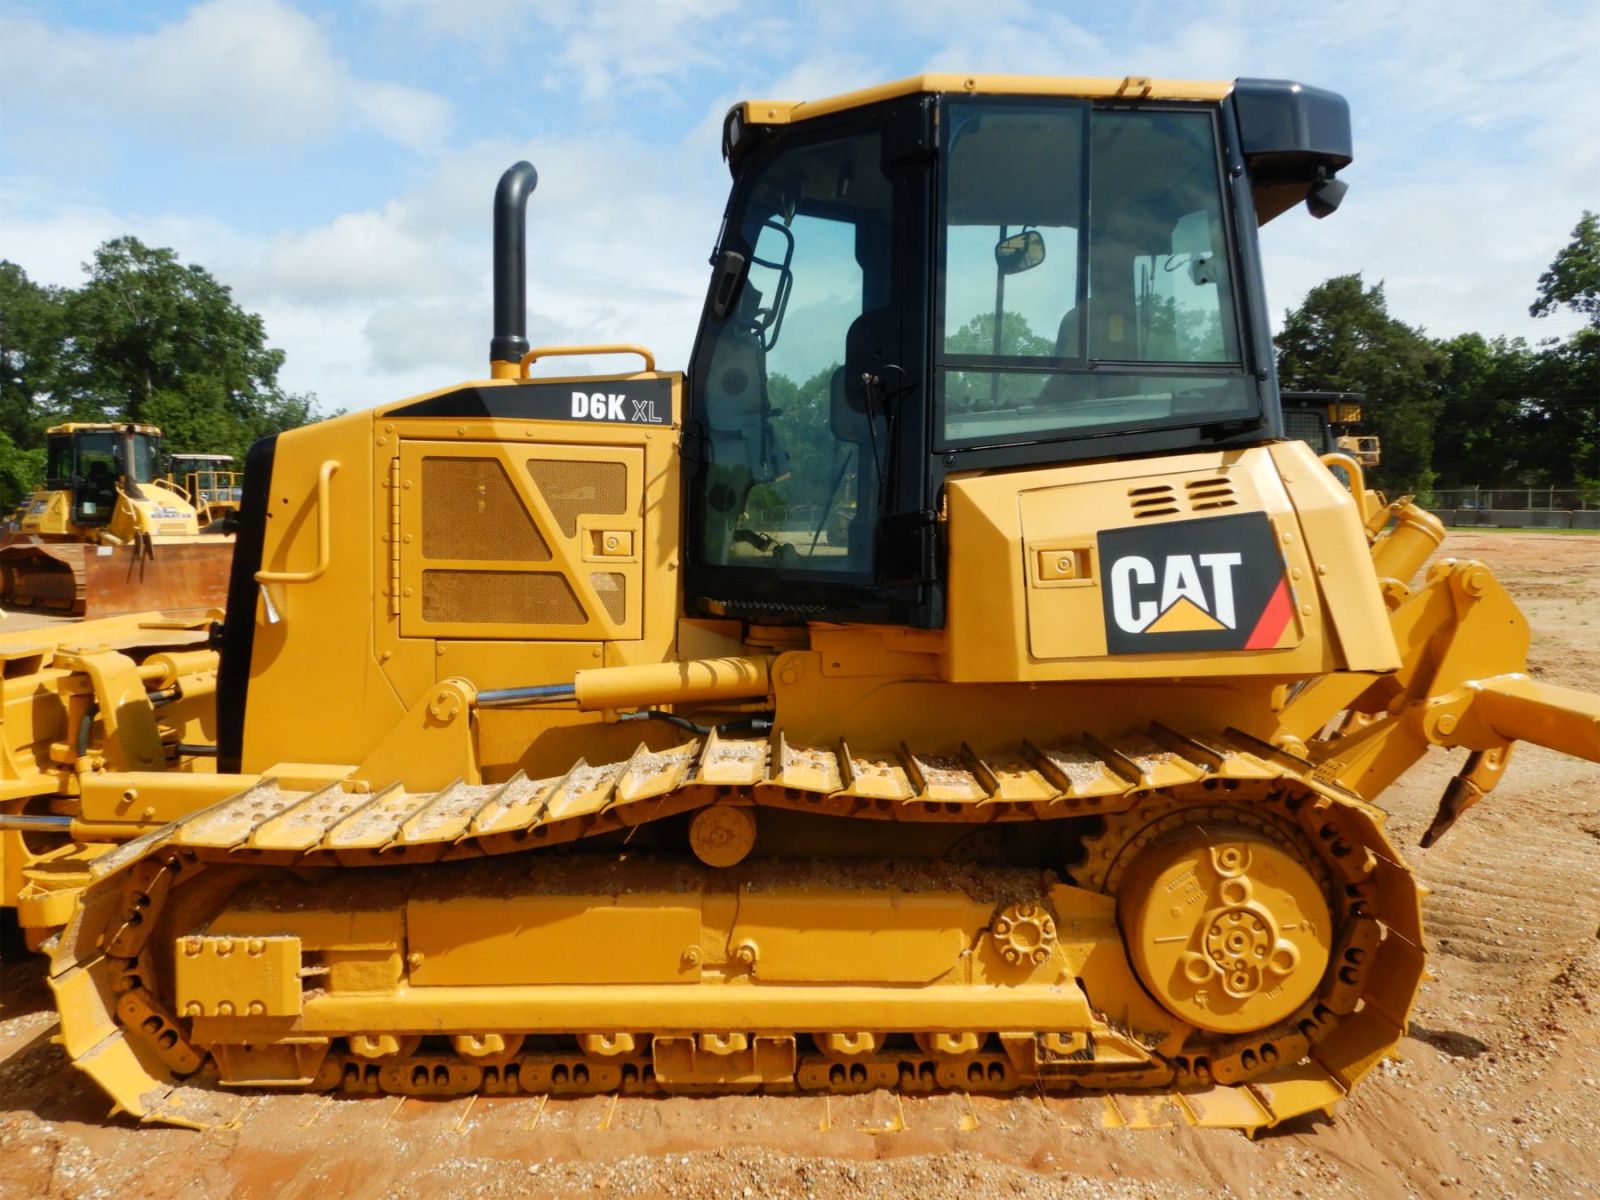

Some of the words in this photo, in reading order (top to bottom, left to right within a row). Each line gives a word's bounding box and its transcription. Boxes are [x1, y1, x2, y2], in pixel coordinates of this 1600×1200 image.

[571, 392, 626, 420] D6K
[632, 400, 662, 422] XL
[1111, 552, 1242, 634] CAT
